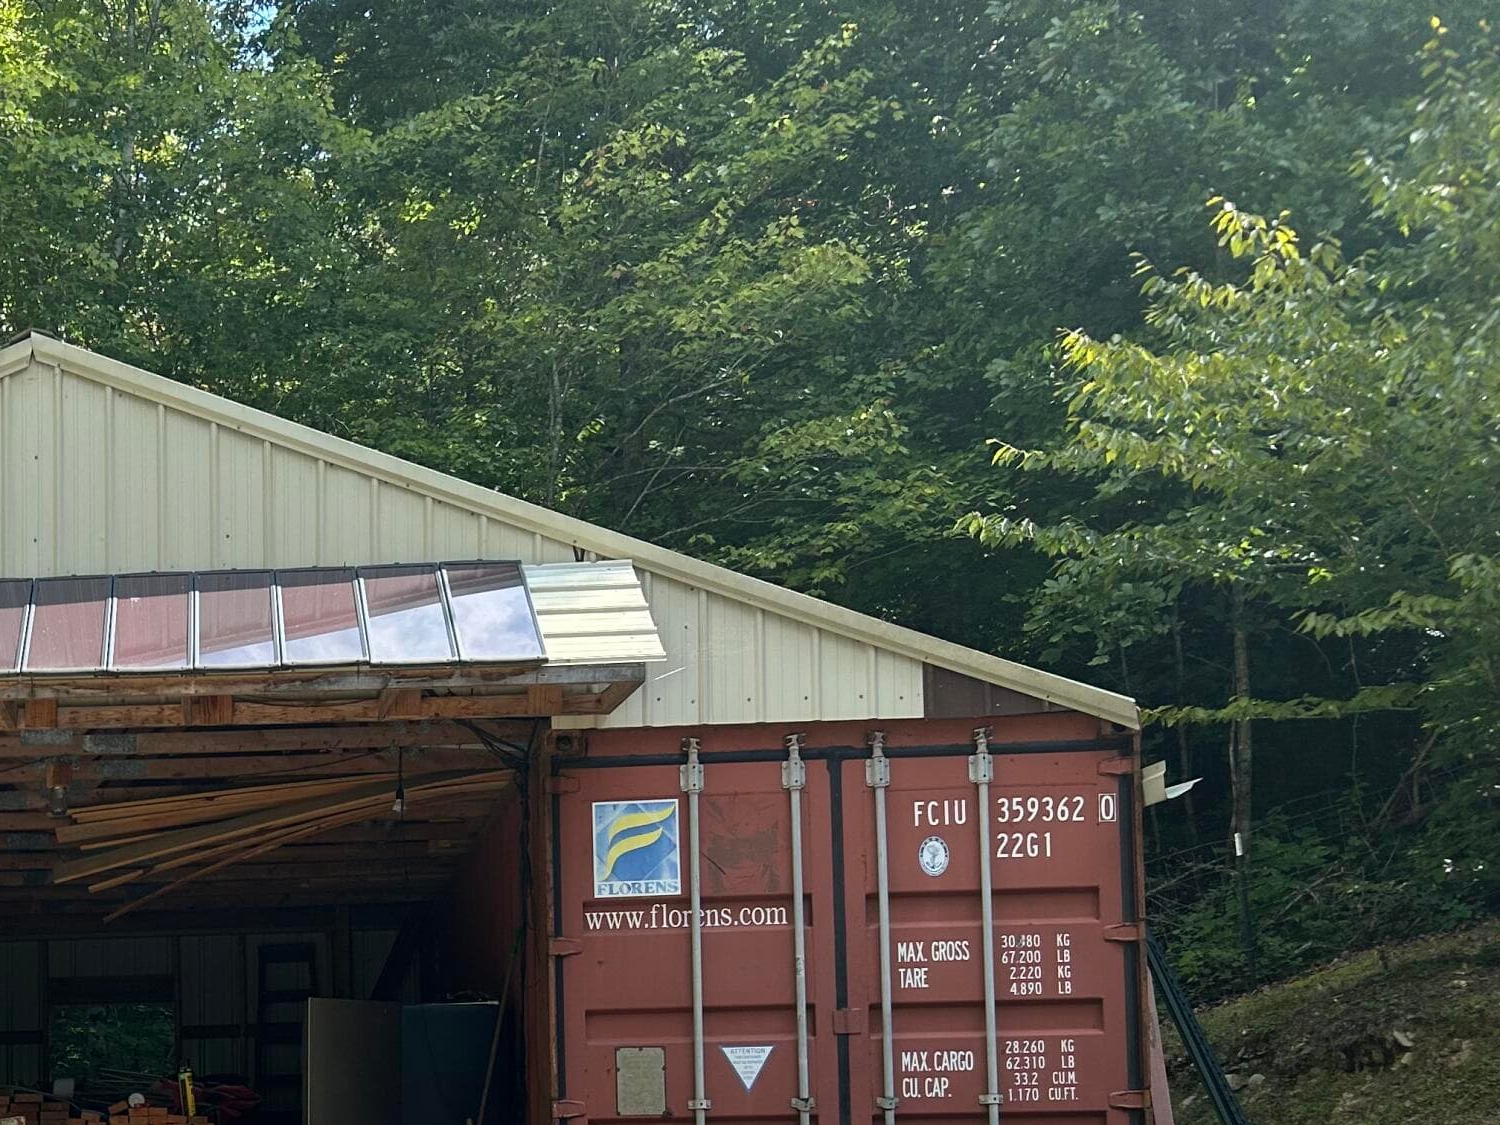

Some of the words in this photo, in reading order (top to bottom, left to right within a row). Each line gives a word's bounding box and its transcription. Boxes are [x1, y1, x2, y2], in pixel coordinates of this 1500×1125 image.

[914, 800, 966, 826] FCIU
[997, 796, 1085, 822] 359362
[997, 832, 1051, 857] 22G1
[598, 880, 679, 896] FLORENS
[584, 904, 788, 930] www.florens.com
[1056, 934, 1070, 947] KG
[898, 942, 928, 962] MAX.
[931, 941, 970, 961] GROSS
[1001, 951, 1041, 964] 67.200
[1057, 950, 1070, 963] LB
[899, 968, 929, 988] TARE
[1010, 967, 1041, 980] 2.220
[1057, 966, 1071, 979] KG
[1010, 982, 1042, 996] 4.890
[1058, 981, 1072, 994] LB
[1006, 1040, 1045, 1053] 28.260
[1060, 1039, 1074, 1052] KG
[902, 1051, 931, 1072] MAX.
[934, 1050, 974, 1071] CARGO
[1006, 1056, 1045, 1069] 62.310
[1061, 1055, 1075, 1069] LB
[1014, 1072, 1038, 1085] 33.2
[902, 1078, 921, 1098] CU.
[925, 1077, 952, 1097] CAP.
[1009, 1088, 1039, 1101] 1.170
